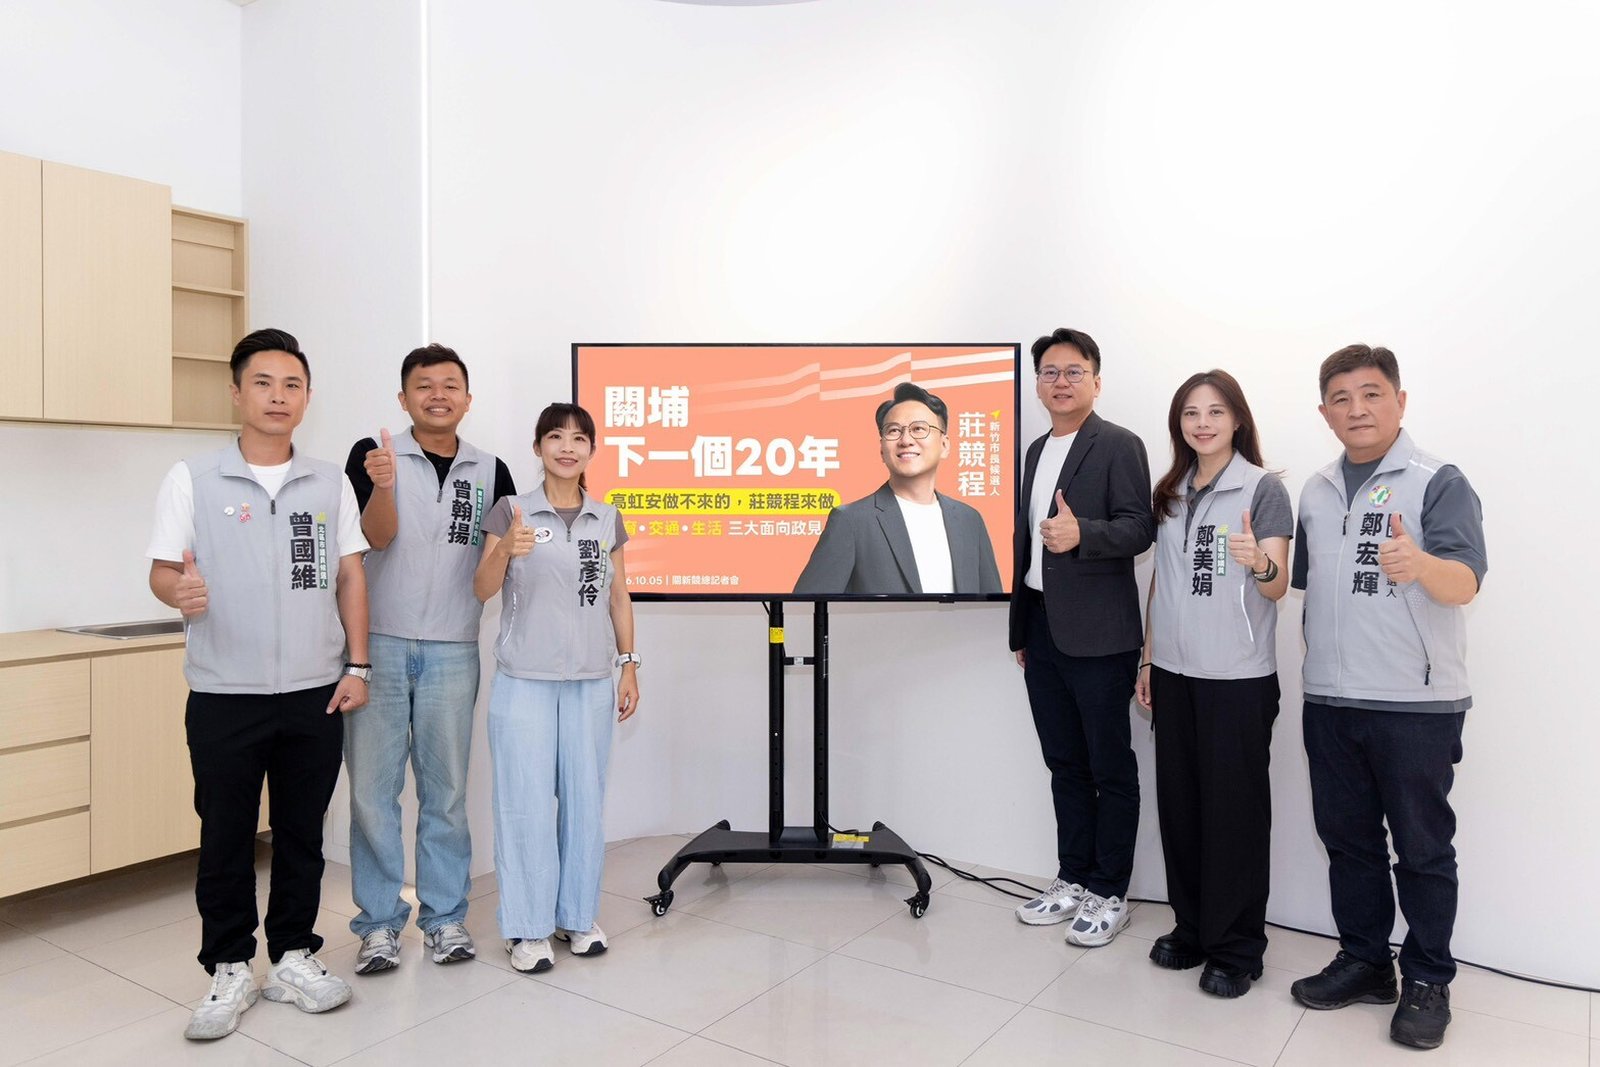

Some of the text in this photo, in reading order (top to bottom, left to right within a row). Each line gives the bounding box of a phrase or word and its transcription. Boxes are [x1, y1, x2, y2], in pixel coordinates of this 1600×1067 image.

[604, 386, 689, 428] 關埔
[604, 435, 840, 478] 下一個20年
[958, 412, 986, 497] 莊競程
[989, 421, 1000, 496] 新竹市長候選人
[448, 479, 473, 546] 曾翰揚
[610, 493, 835, 510] 高虹安做不來的，莊競程來做
[728, 520, 822, 536] 三大面向政見
[289, 511, 317, 590] 曾國維
[578, 539, 600, 607] 劉彥伶
[626, 576, 662, 585] 6.10.05
[1191, 524, 1216, 597] 鄭美娟
[1351, 512, 1384, 597] 鄭宏輝
